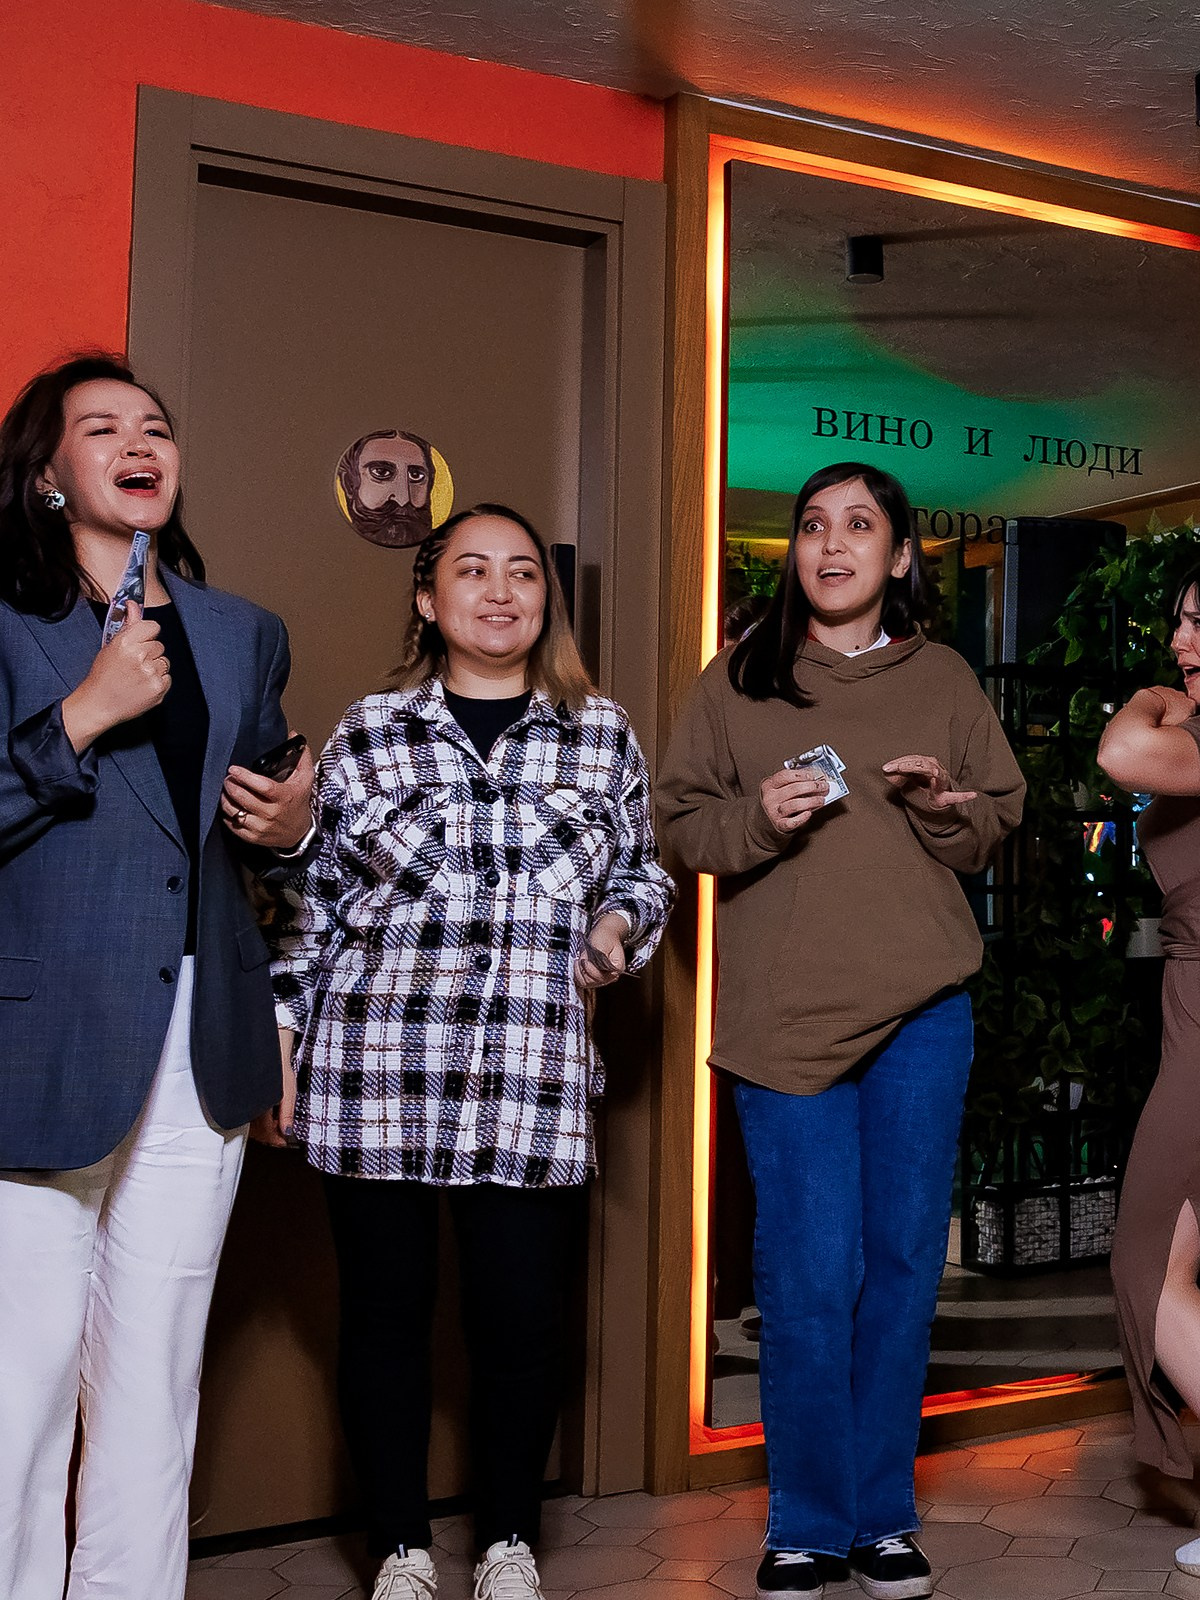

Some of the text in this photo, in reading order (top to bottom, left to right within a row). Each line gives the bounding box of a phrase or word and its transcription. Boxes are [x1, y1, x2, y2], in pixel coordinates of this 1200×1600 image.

[811, 406, 1143, 480] вино и люди
